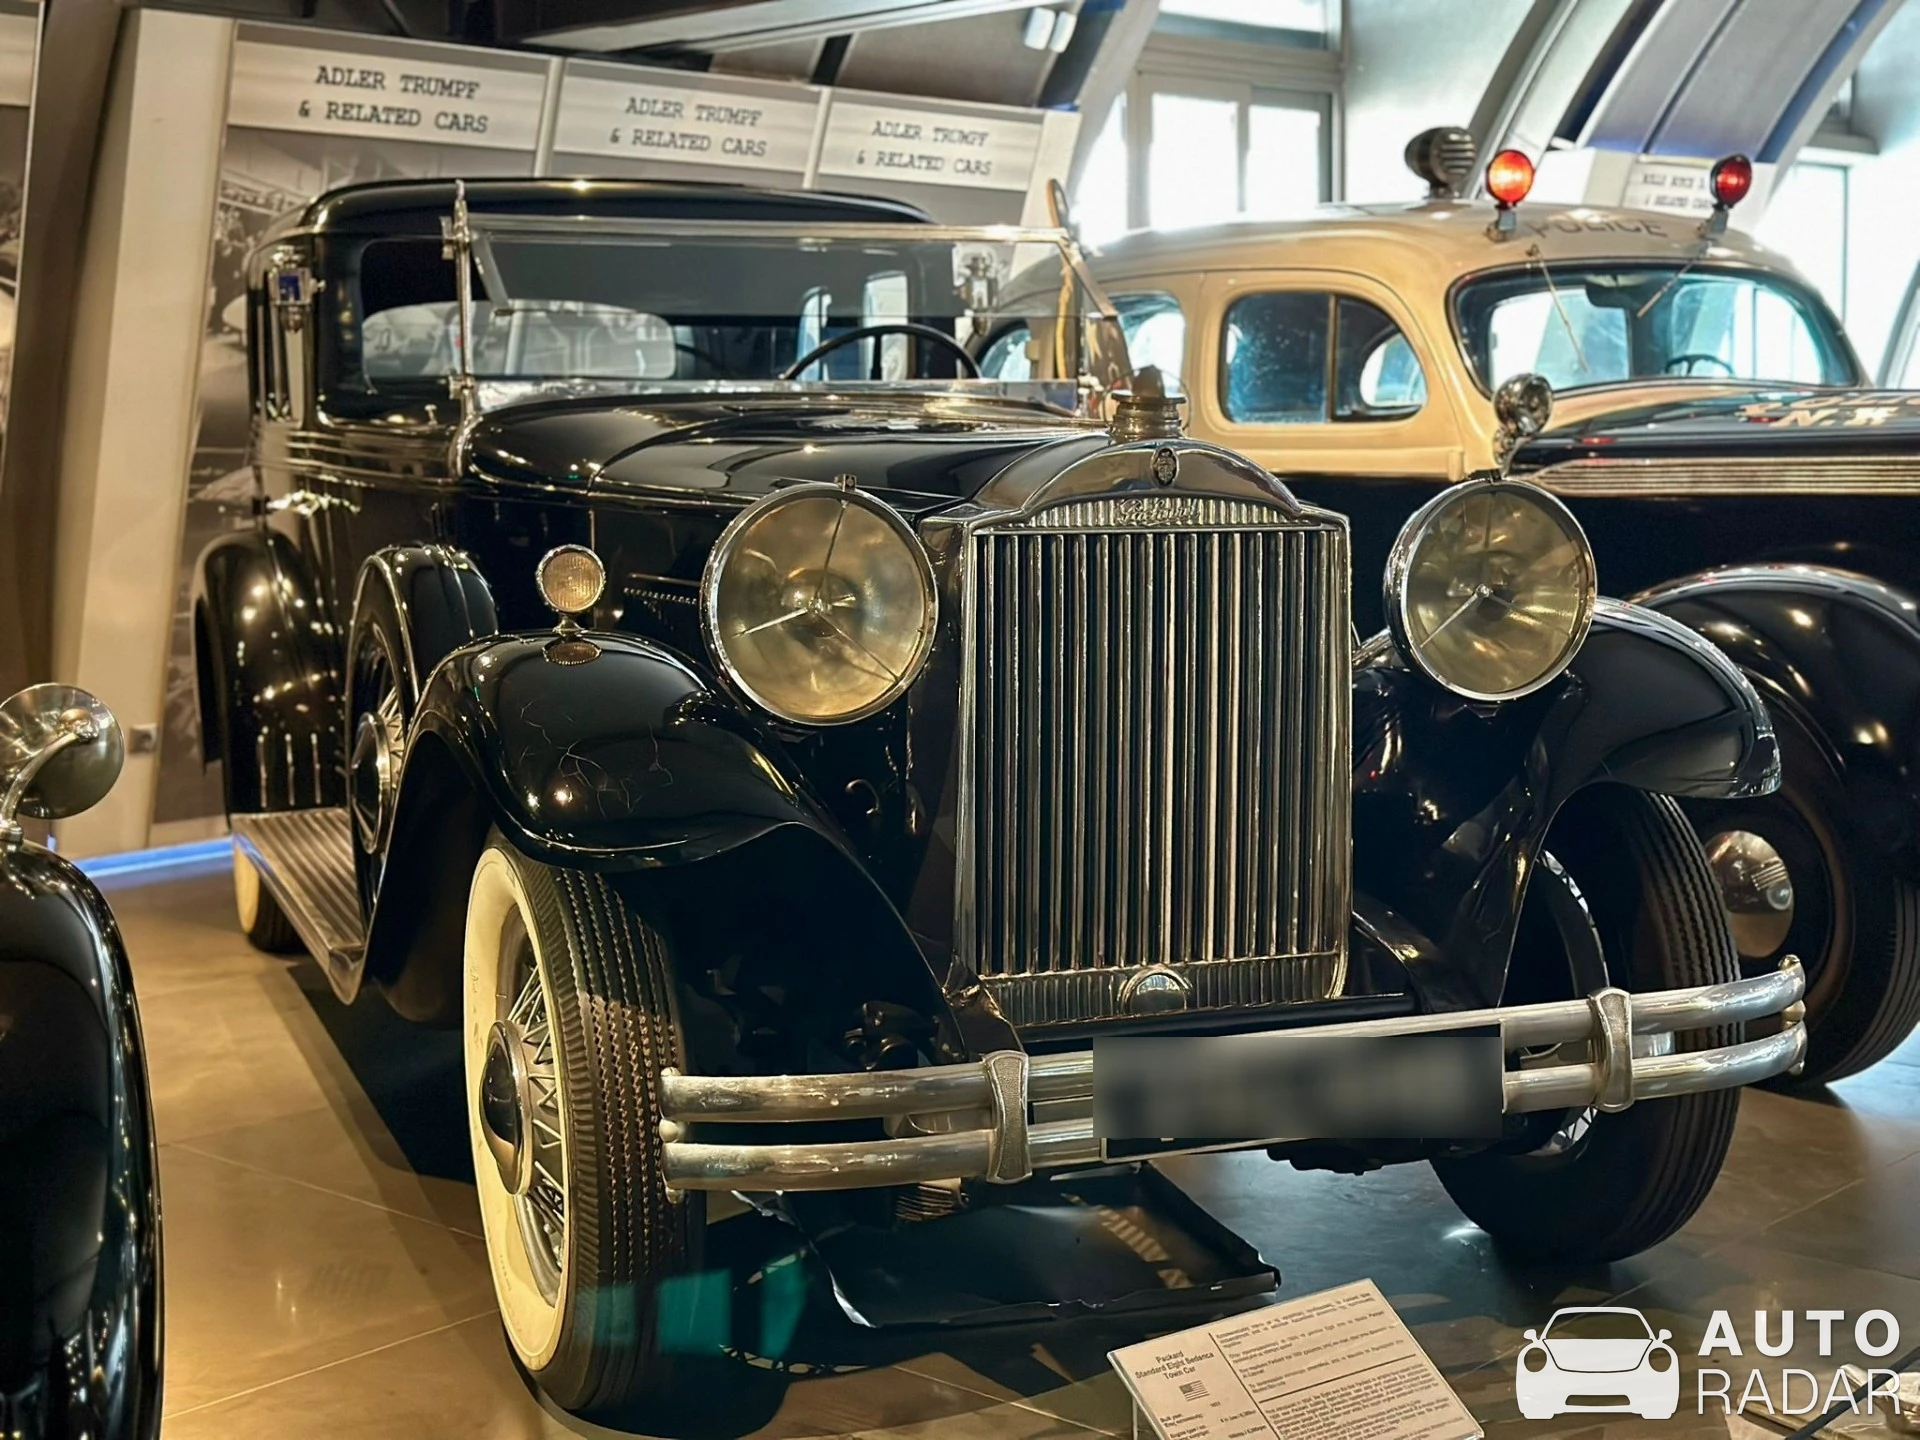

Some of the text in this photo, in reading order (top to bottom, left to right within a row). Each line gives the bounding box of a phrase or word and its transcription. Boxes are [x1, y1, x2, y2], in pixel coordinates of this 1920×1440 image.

[315, 65, 481, 99] ADLER TRUMPF
[298, 100, 489, 133] & RELATED CARS
[625, 97, 763, 127] ADLER TRUMPF
[872, 120, 922, 140] ADLER
[609, 128, 768, 157] & RELATED CARS
[875, 151, 945, 171] RELATED
[953, 158, 992, 175] CARS
[1134, 1363, 1167, 1379] Standard
[1166, 1359, 1185, 1371] Eight
[1155, 1350, 1184, 1364] Packard
[1162, 1366, 1196, 1380] Town Car
